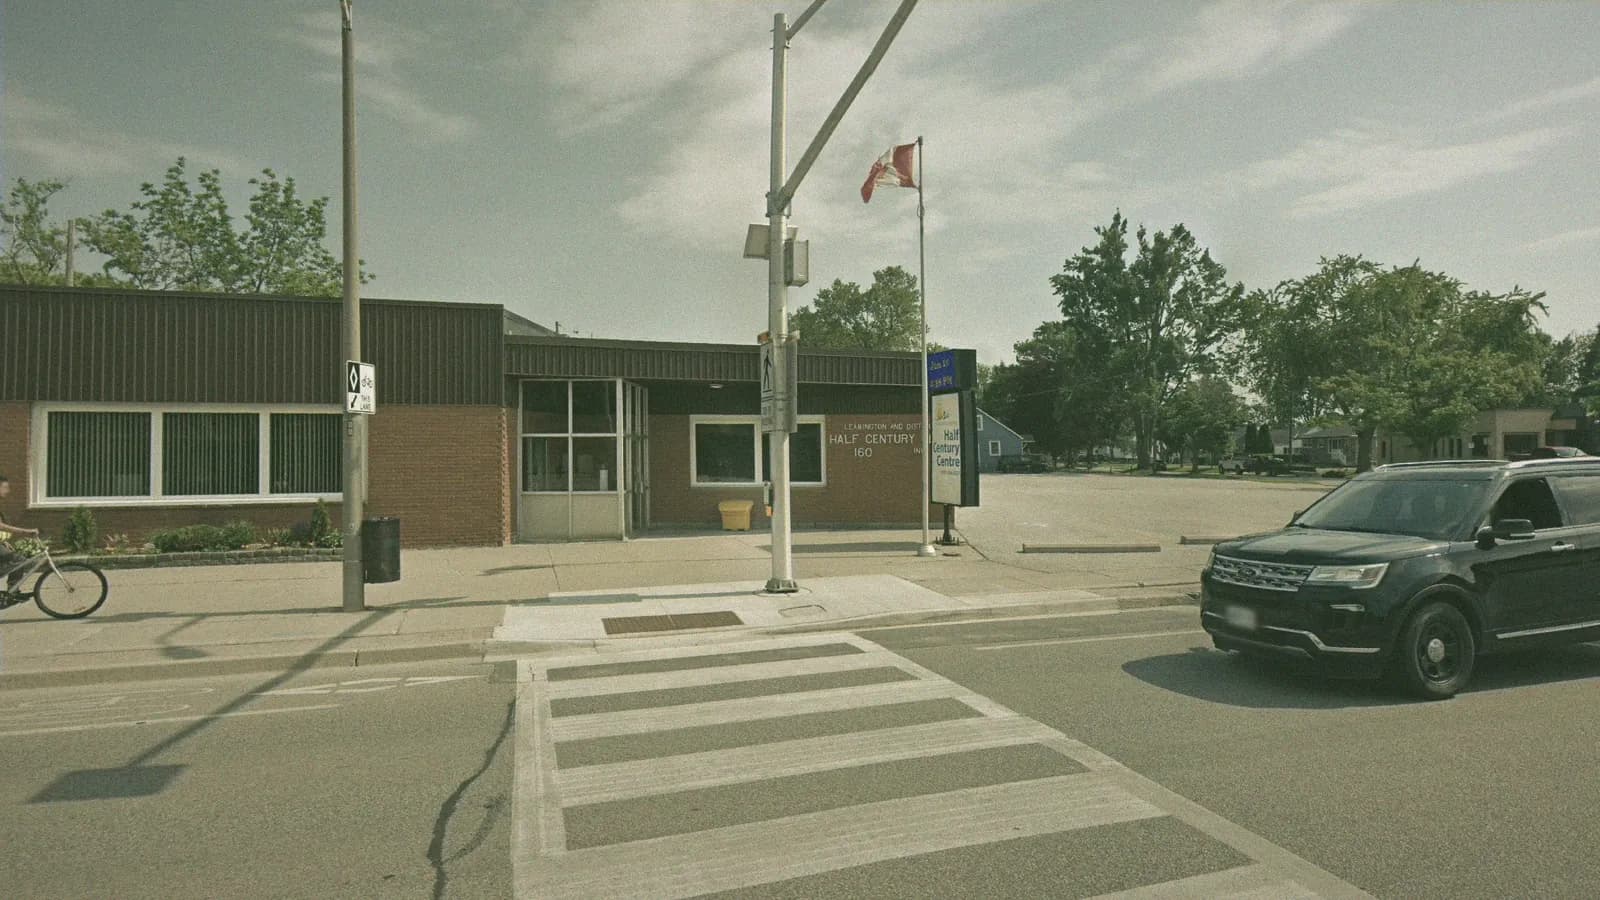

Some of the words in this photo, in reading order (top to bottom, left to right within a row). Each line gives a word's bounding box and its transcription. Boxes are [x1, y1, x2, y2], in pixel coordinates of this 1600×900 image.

[843, 423, 887, 431] LEAMINGTON
[829, 433, 859, 444] HALF
[865, 433, 916, 444] CENTURY
[943, 428, 960, 440] Half
[854, 447, 873, 457] 160
[933, 442, 960, 456] Century
[936, 455, 961, 467] Centre
